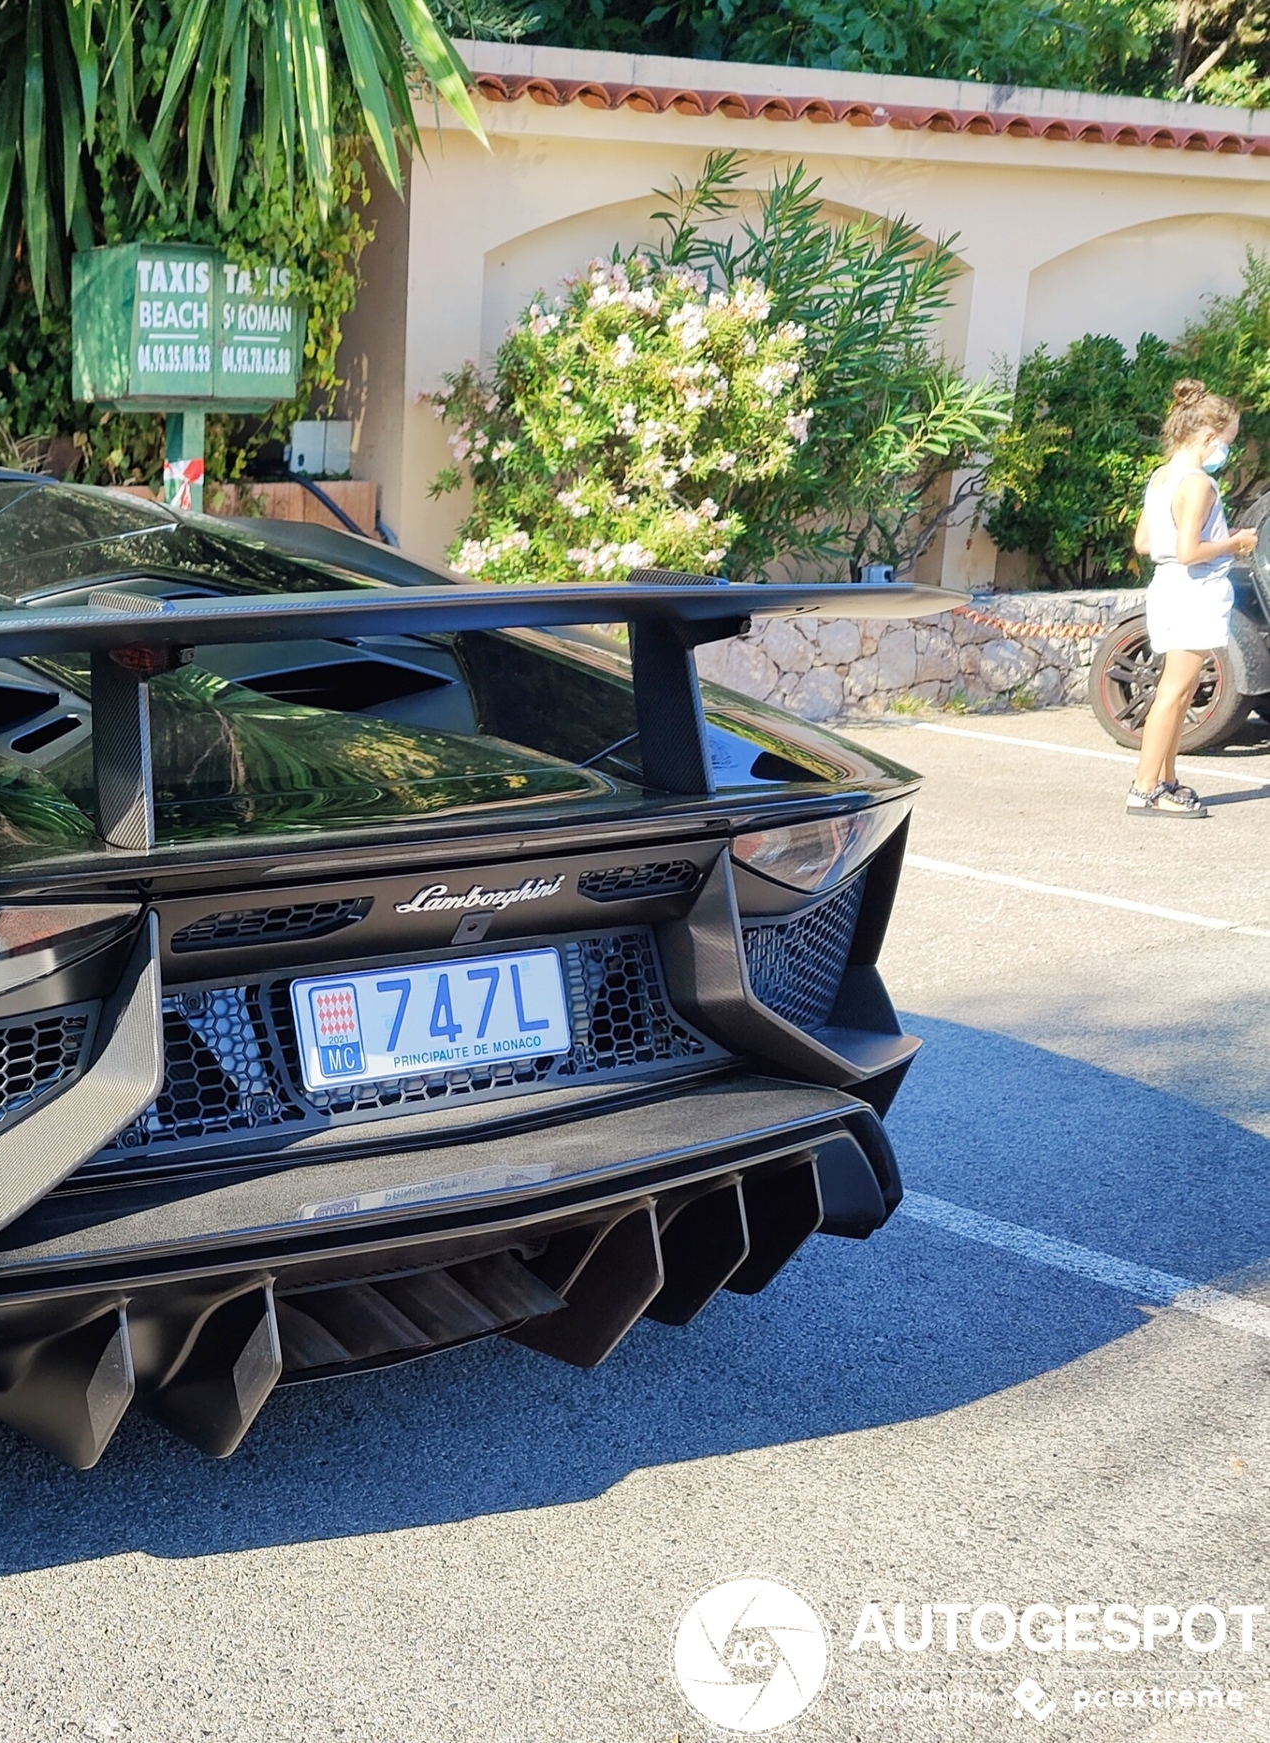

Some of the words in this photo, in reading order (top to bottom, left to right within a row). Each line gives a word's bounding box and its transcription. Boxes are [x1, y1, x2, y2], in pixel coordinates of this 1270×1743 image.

[137, 260, 209, 293] TAXIS
[139, 301, 208, 329] BEACH
[238, 304, 292, 332] ROMAN
[395, 873, 565, 913] Lamborghini
[377, 964, 549, 1052] 747L
[328, 1035, 349, 1044] 2021
[393, 1047, 469, 1068] PRINCIPAUTE
[474, 1043, 489, 1056] DE
[493, 1036, 542, 1052] MONACO
[330, 1047, 355, 1071] MC
